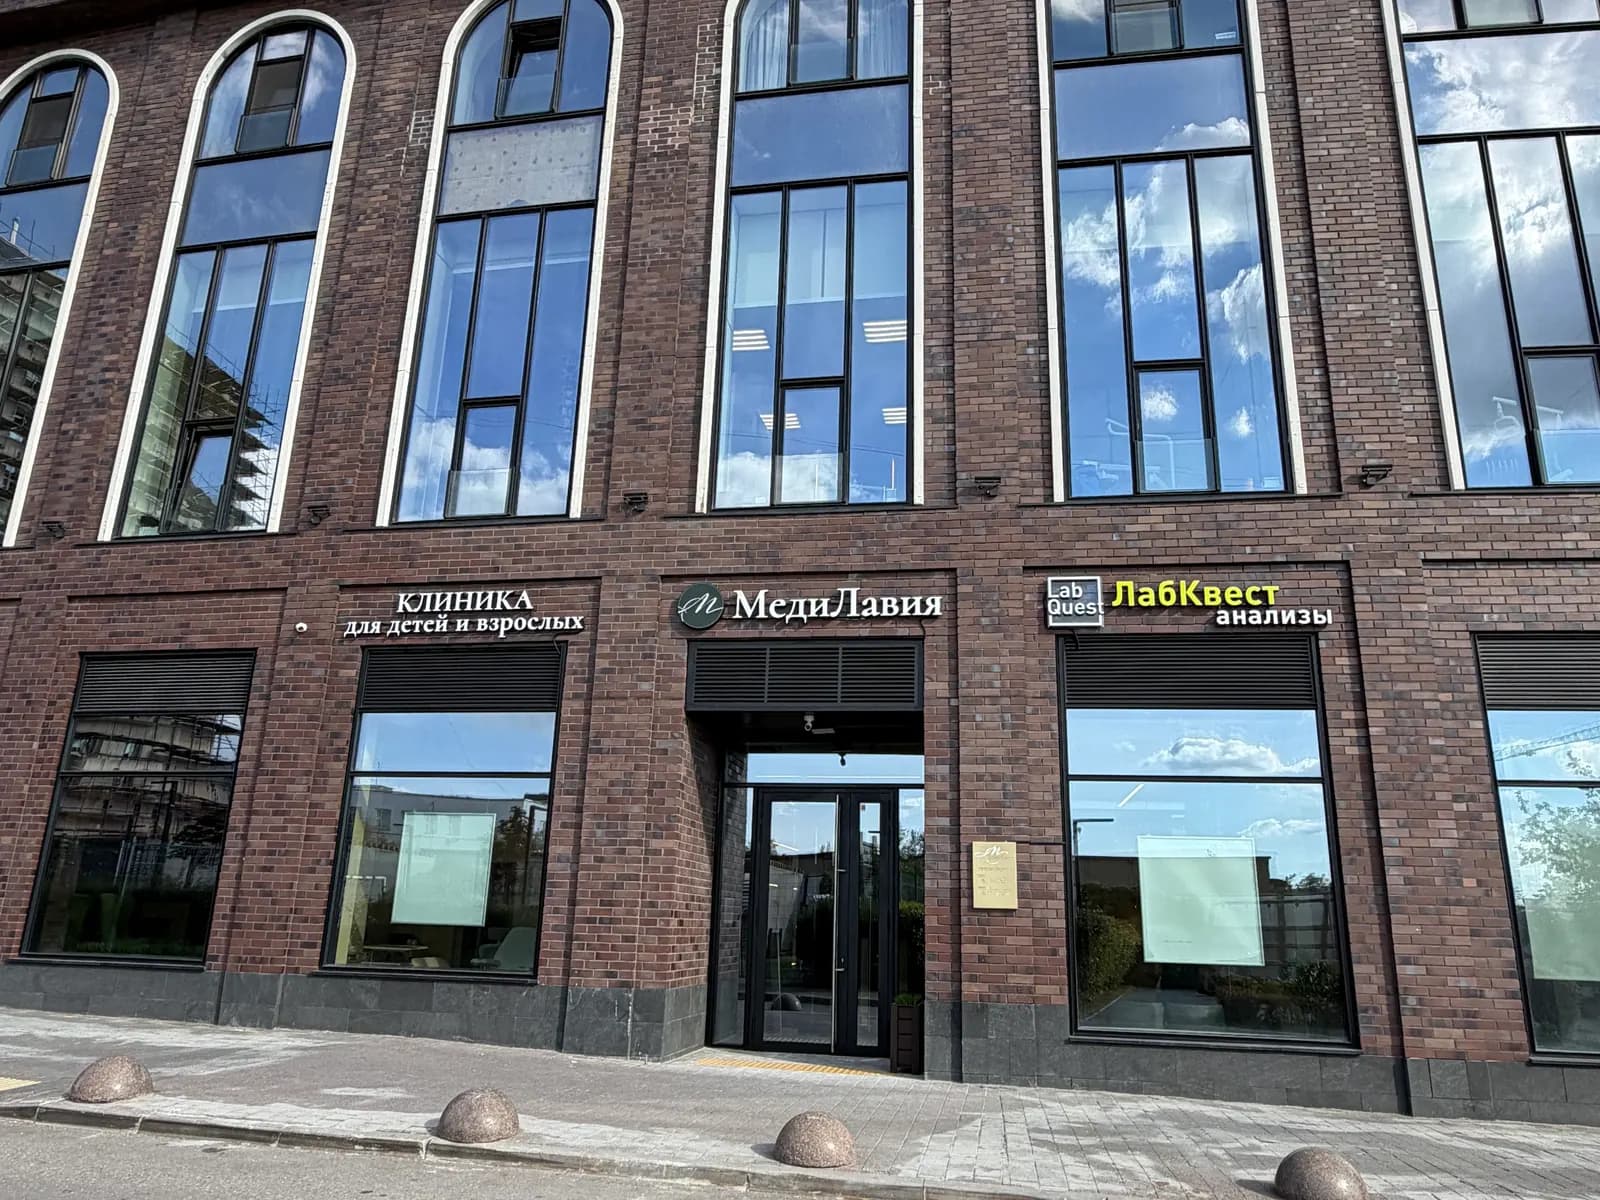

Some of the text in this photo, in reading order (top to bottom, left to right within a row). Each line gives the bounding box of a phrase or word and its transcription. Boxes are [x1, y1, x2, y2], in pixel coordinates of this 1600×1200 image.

[396, 590, 534, 613] КЛИНИКА
[1047, 582, 1083, 599] Lab
[1112, 580, 1280, 607] ЛабКвест
[733, 587, 943, 623] МедиЛавия
[1047, 600, 1105, 615] Quest
[1216, 608, 1333, 625] анализы
[344, 614, 584, 638] для детей и взрослых
